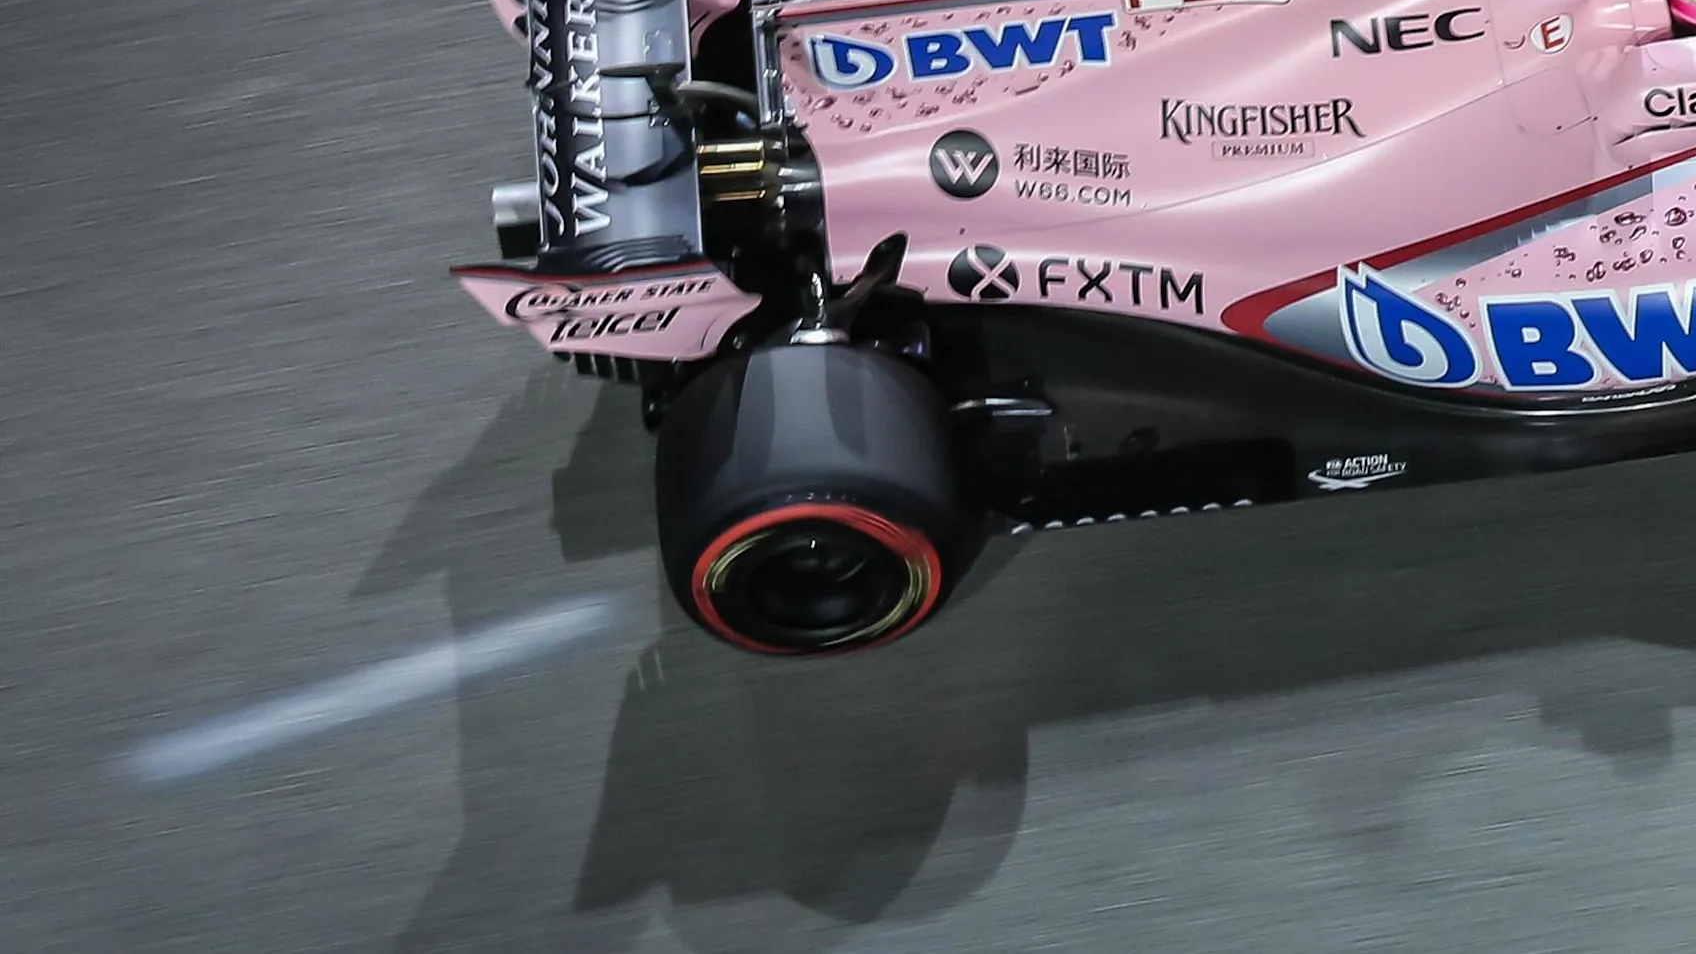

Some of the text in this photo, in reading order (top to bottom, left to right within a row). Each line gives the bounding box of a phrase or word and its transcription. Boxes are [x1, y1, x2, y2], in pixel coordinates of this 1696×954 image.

[905, 12, 1116, 80] BWT
[1328, 7, 1486, 59] NEC
[1540, 16, 1565, 50] E
[1160, 97, 1366, 145] KINGFISHER
[1013, 143, 1132, 180] 利来国际
[1221, 142, 1305, 157] PREMIUM
[1014, 180, 1133, 208] W66.COM
[640, 277, 716, 300] STATE
[1038, 257, 1205, 315] FXTM
[1344, 453, 1389, 469] ACTION
